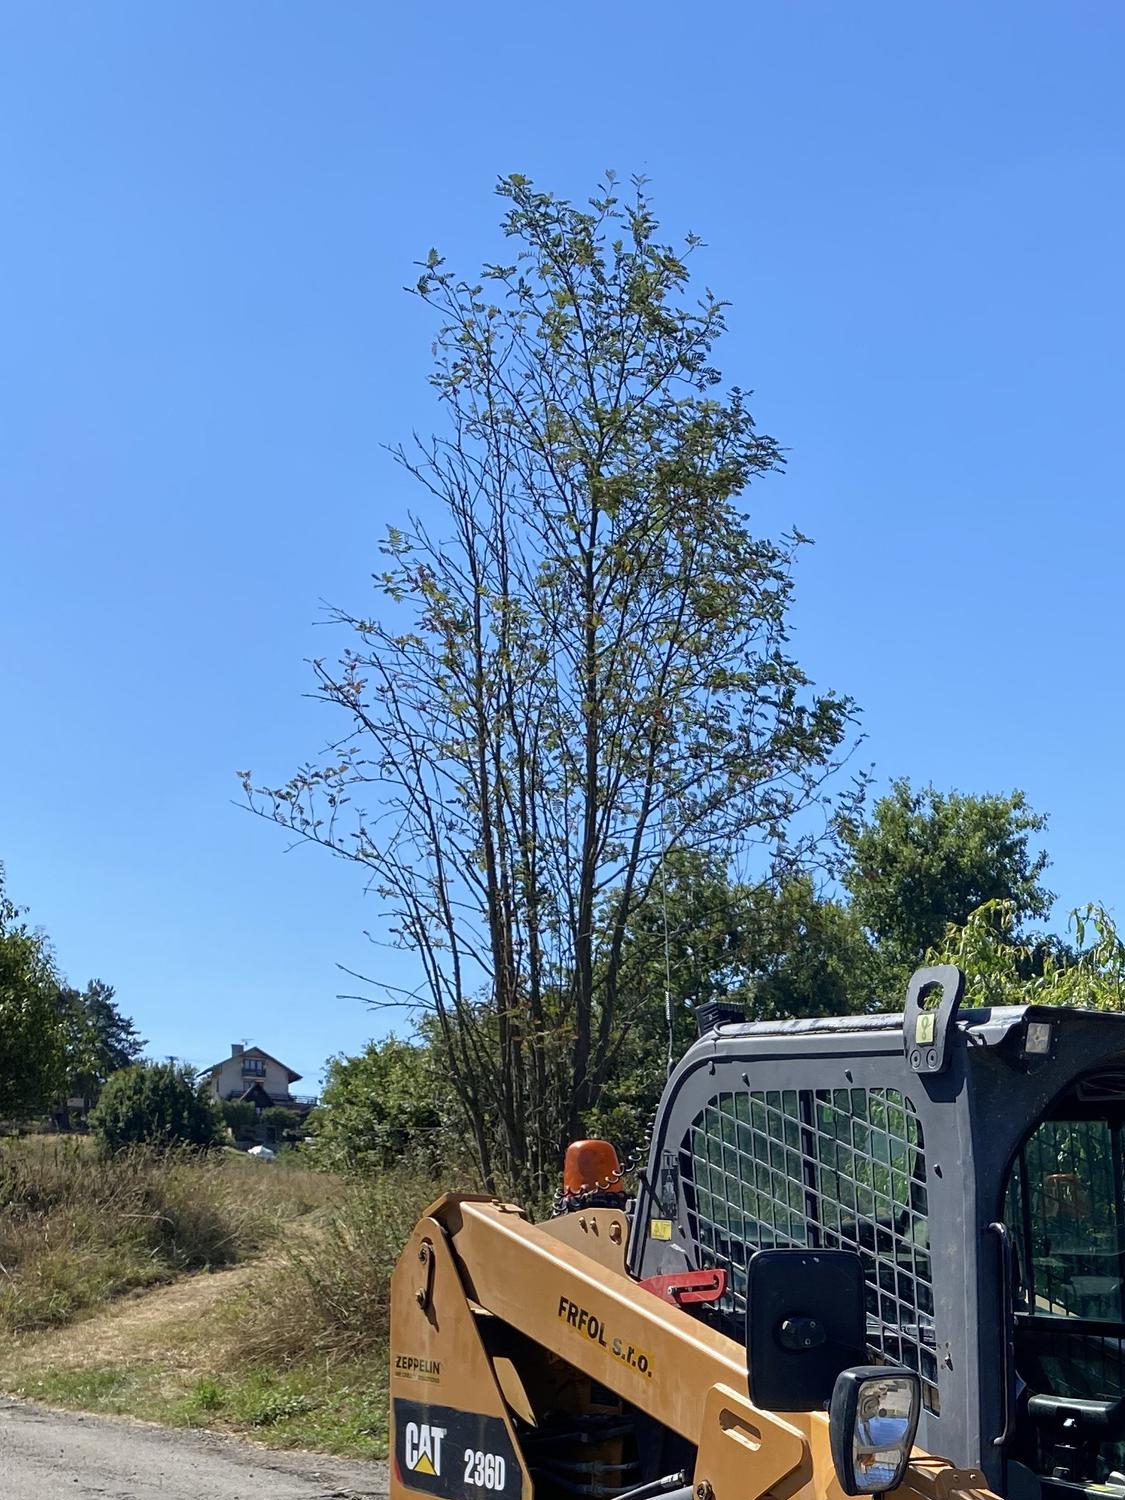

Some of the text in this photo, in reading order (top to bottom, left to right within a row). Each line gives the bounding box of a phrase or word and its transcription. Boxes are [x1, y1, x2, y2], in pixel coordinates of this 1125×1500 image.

[558, 1296, 653, 1378] FRFOL s.r.o.
[395, 1356, 441, 1375] ZEPPELIN
[405, 1421, 446, 1477] CAT
[464, 1448, 506, 1491] 236D
